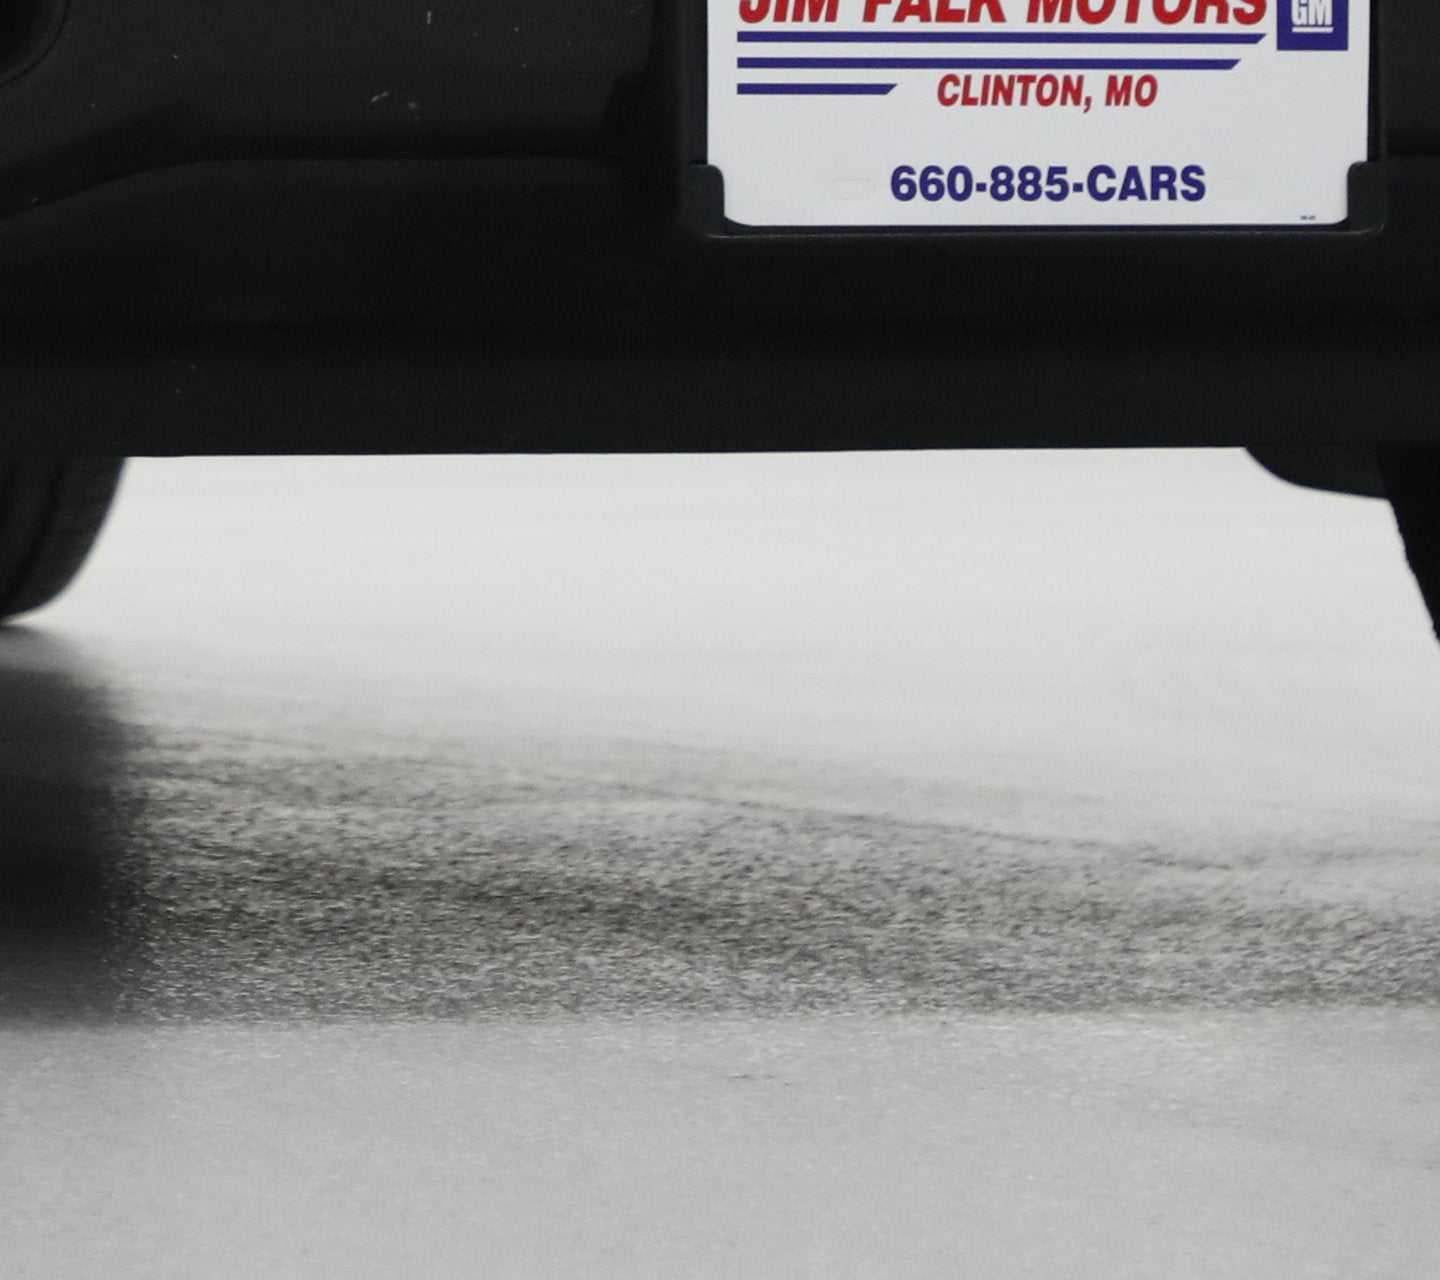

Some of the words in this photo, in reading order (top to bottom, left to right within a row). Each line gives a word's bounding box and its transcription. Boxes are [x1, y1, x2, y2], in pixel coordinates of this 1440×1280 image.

[937, 73, 1092, 114] CLINTON,
[1104, 74, 1159, 107] MO
[889, 164, 1207, 202] 660-885-CARS
